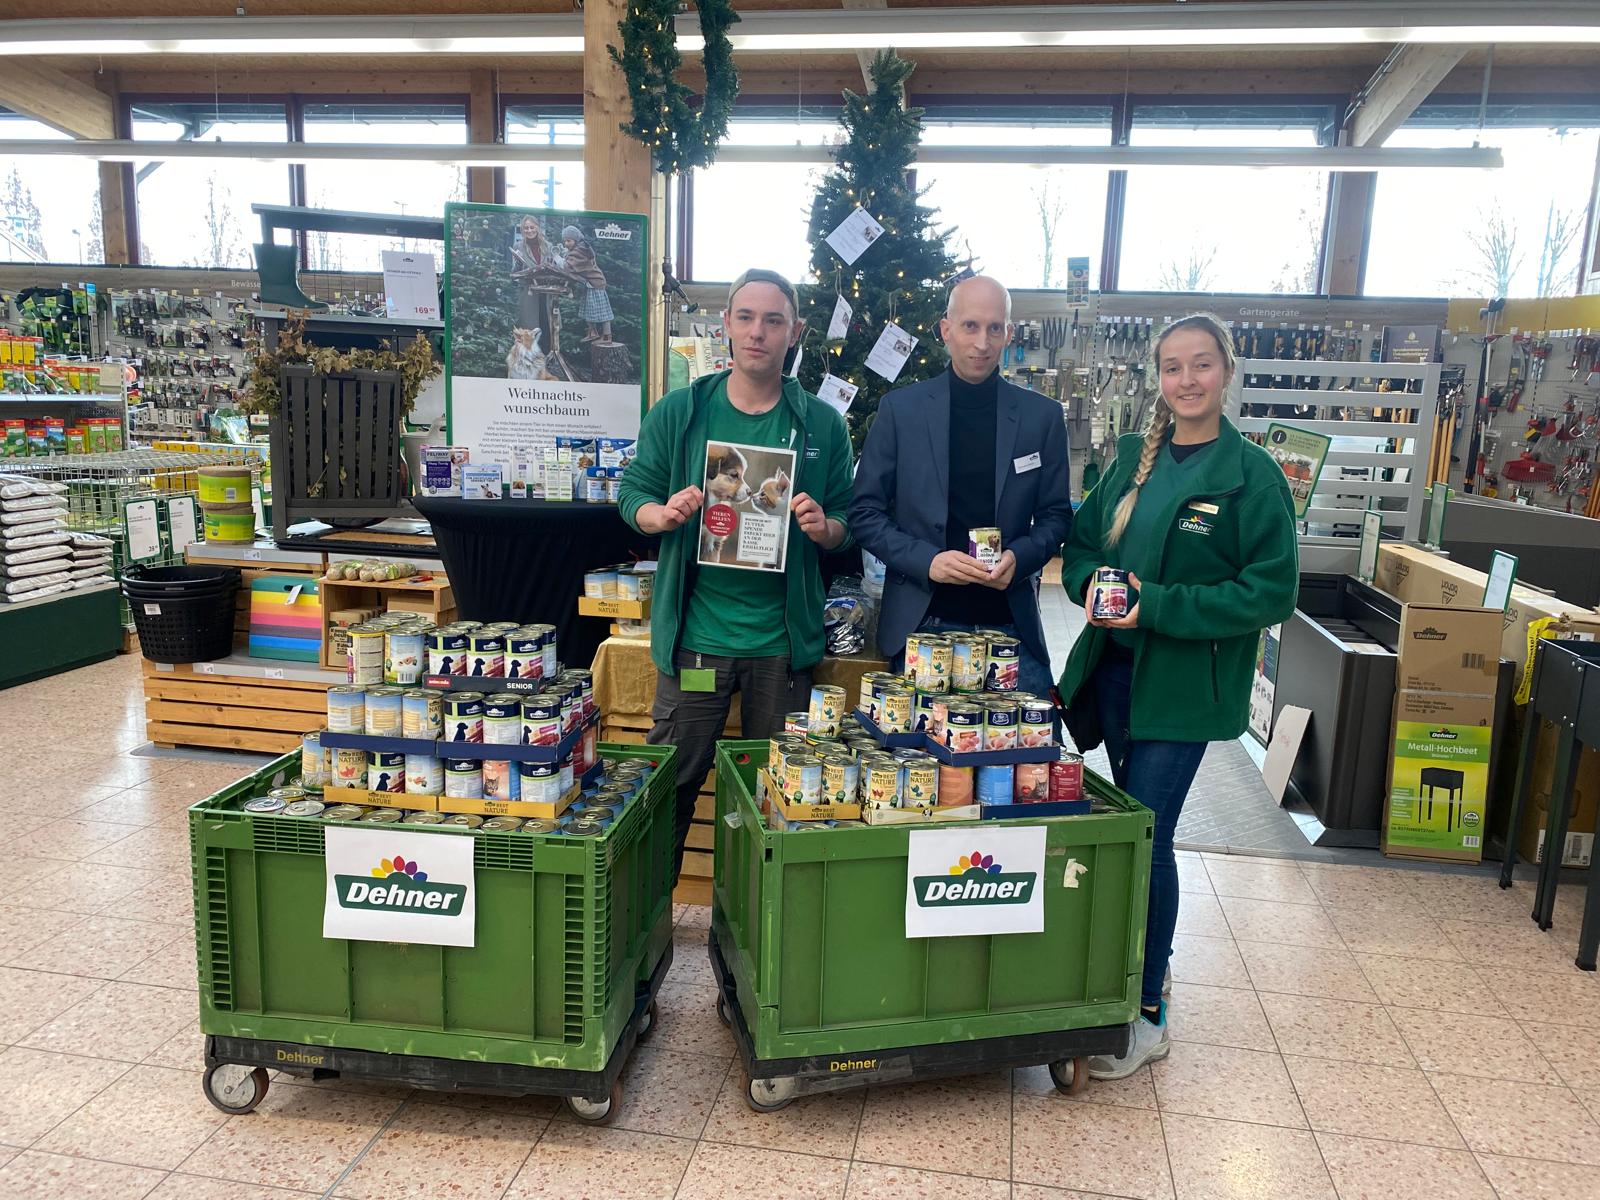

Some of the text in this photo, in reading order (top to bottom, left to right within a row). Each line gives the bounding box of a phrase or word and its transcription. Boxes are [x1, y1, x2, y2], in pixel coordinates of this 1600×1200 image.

[597, 230, 630, 240] Dehner
[231, 279, 262, 288] Bewässe
[1239, 307, 1300, 318] Gartengeräte
[508, 387, 587, 402] Weihnachts-
[504, 403, 590, 418] wunschbaum
[1182, 521, 1212, 533] Dehner
[506, 682, 534, 690] SENIOR
[1431, 732, 1457, 740] Dehner
[1407, 743, 1479, 755] Metall-Hochbeet
[871, 777, 896, 786] NATURE
[910, 776, 935, 784] NATURE
[367, 797, 392, 806] NATURE
[484, 806, 509, 815] NATURE
[924, 877, 1028, 902] Dehner
[346, 882, 458, 912] Dehner
[276, 1049, 325, 1065] Dehner
[829, 1057, 877, 1073] Dehner
